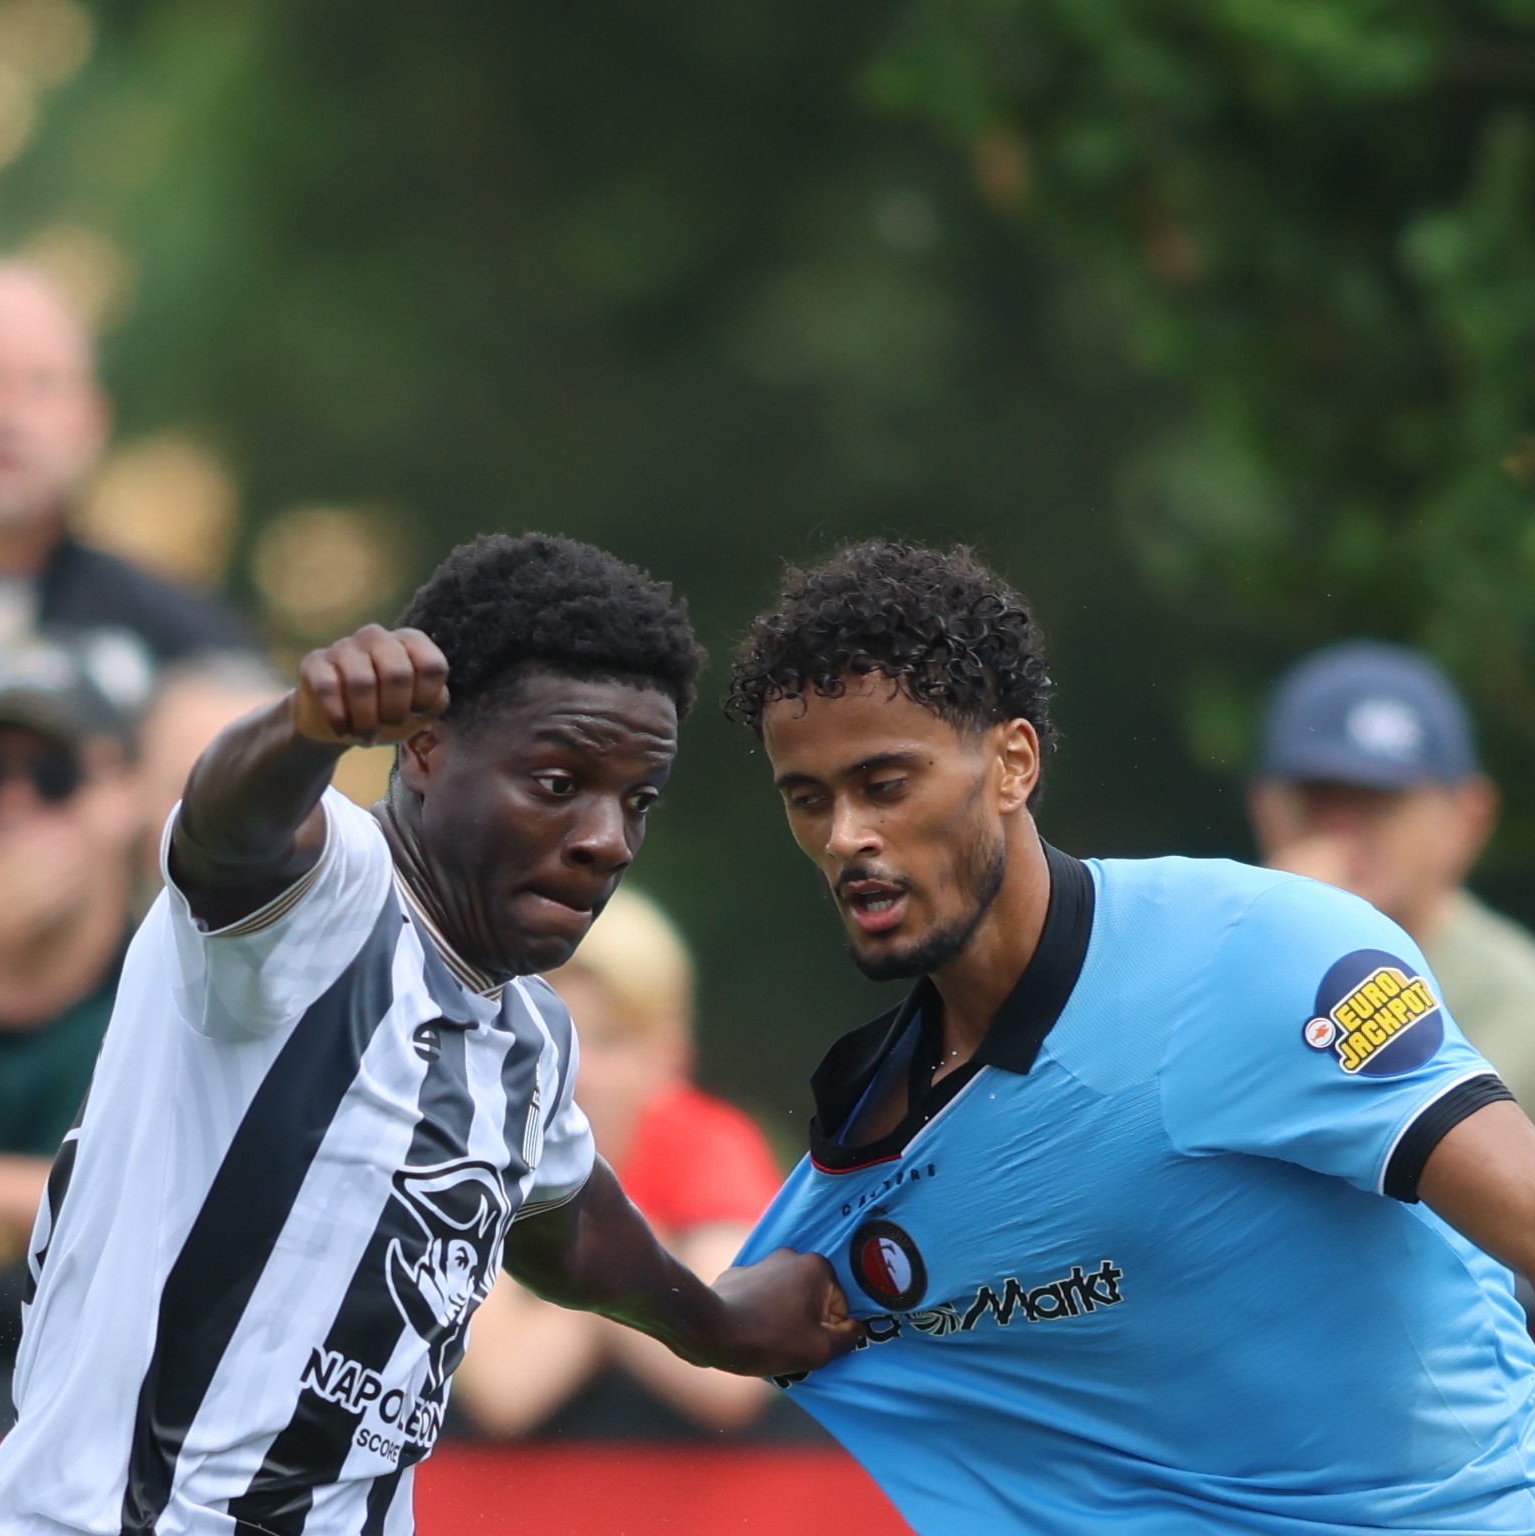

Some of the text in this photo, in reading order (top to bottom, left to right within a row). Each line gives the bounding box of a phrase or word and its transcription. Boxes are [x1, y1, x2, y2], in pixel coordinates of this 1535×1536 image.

[1335, 971, 1401, 1032] EURO
[1340, 981, 1434, 1070] JACKPOT
[299, 1346, 444, 1444] NAPOEON
